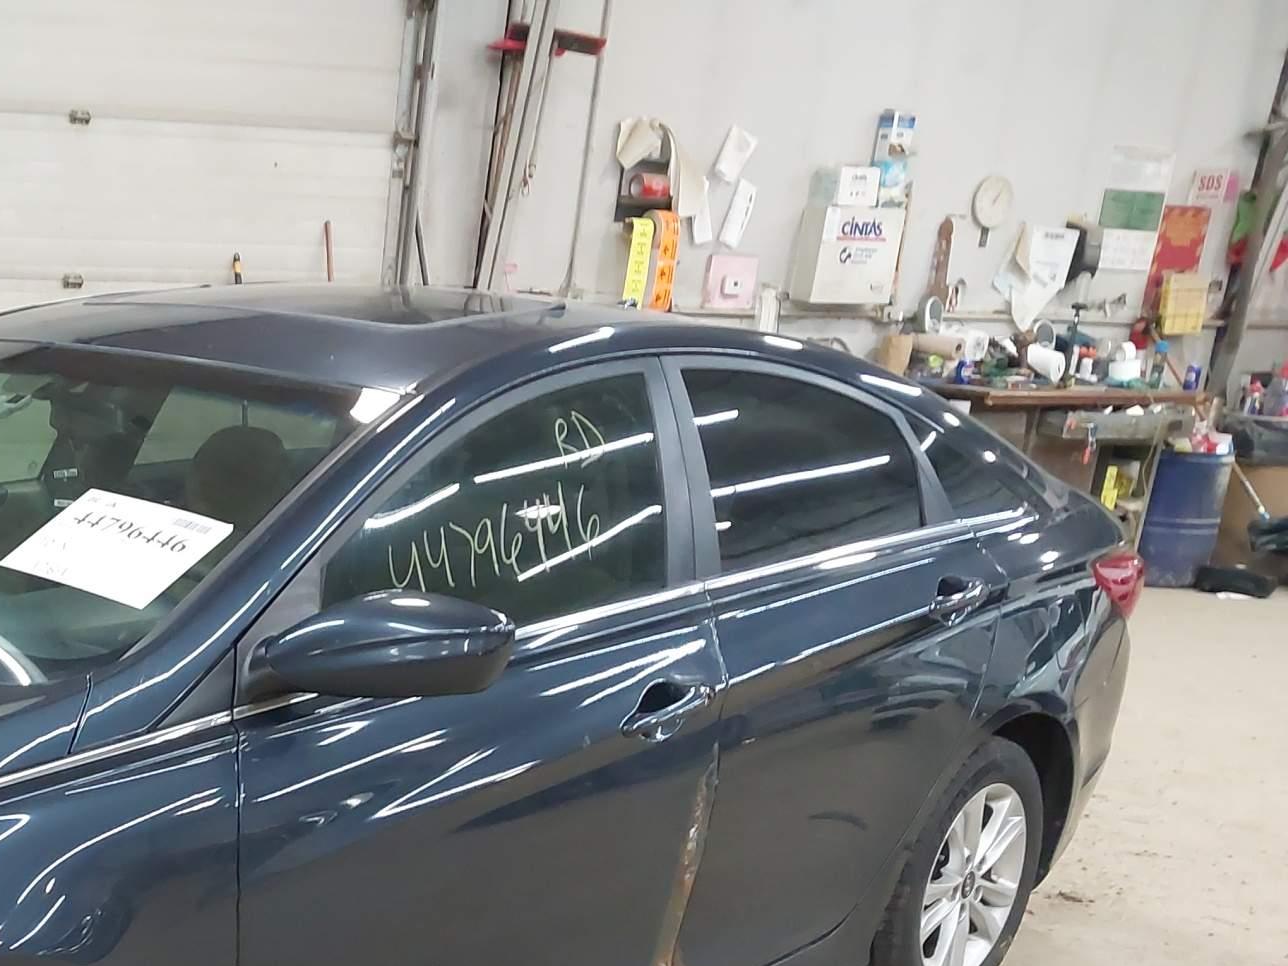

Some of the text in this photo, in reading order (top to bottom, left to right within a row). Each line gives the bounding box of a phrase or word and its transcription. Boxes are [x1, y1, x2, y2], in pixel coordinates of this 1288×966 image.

[1197, 175, 1224, 191] SDS
[841, 216, 883, 236] CINTAS
[73, 511, 187, 553] 44796446
[387, 481, 600, 592] 44796446
